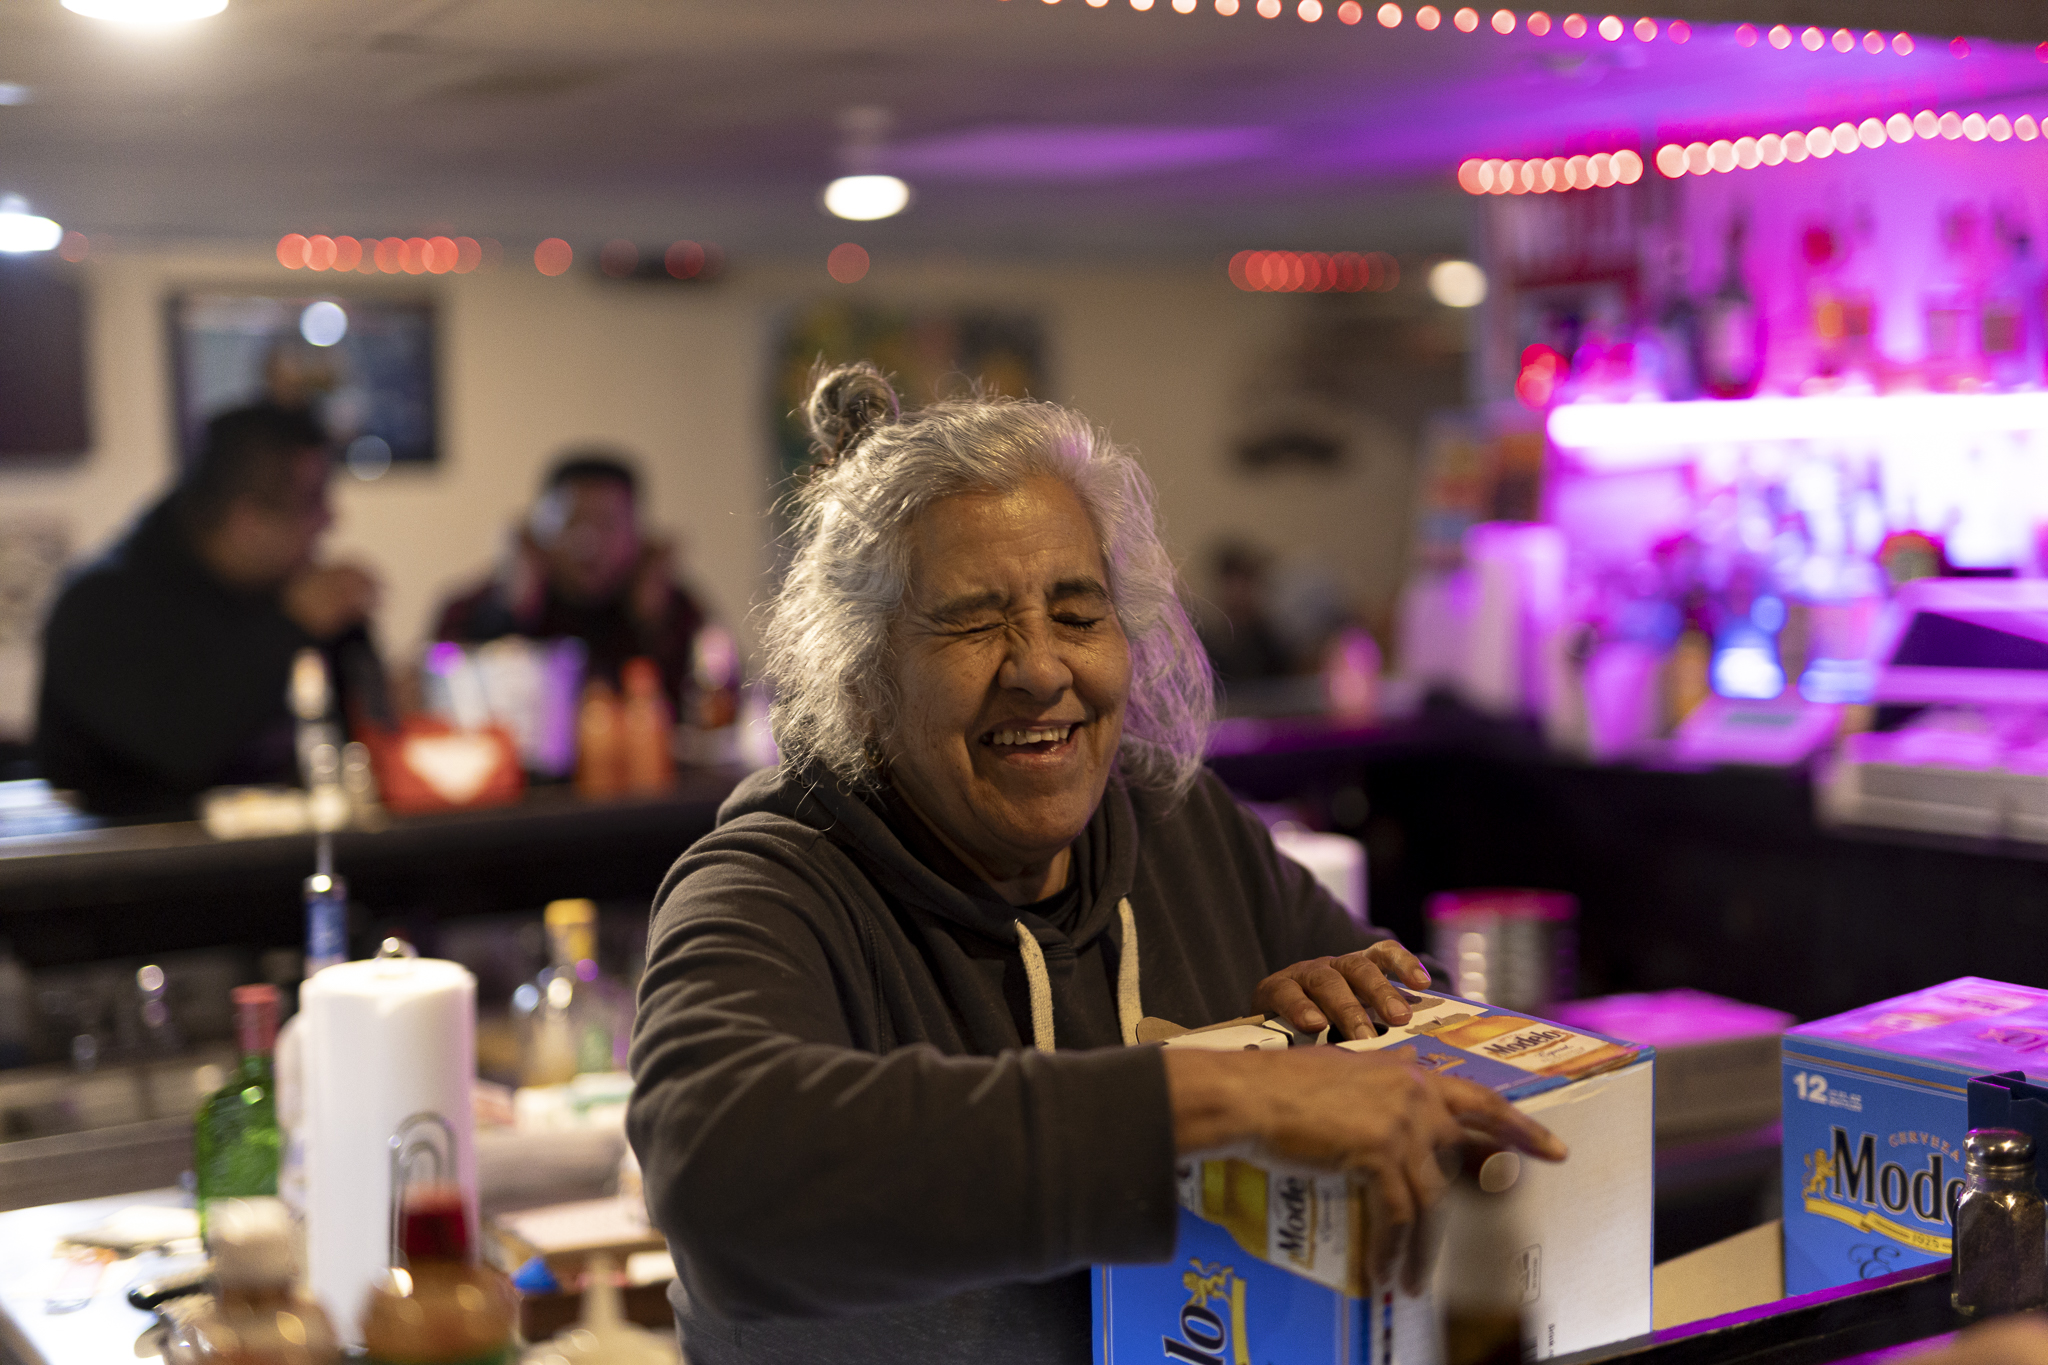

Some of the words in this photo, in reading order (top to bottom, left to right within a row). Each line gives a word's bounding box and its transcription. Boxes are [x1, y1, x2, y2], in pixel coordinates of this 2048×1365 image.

[1482, 1029, 1561, 1057] Modelo
[1793, 1071, 1828, 1105] 12
[1889, 1130, 1960, 1163] CERVEZA
